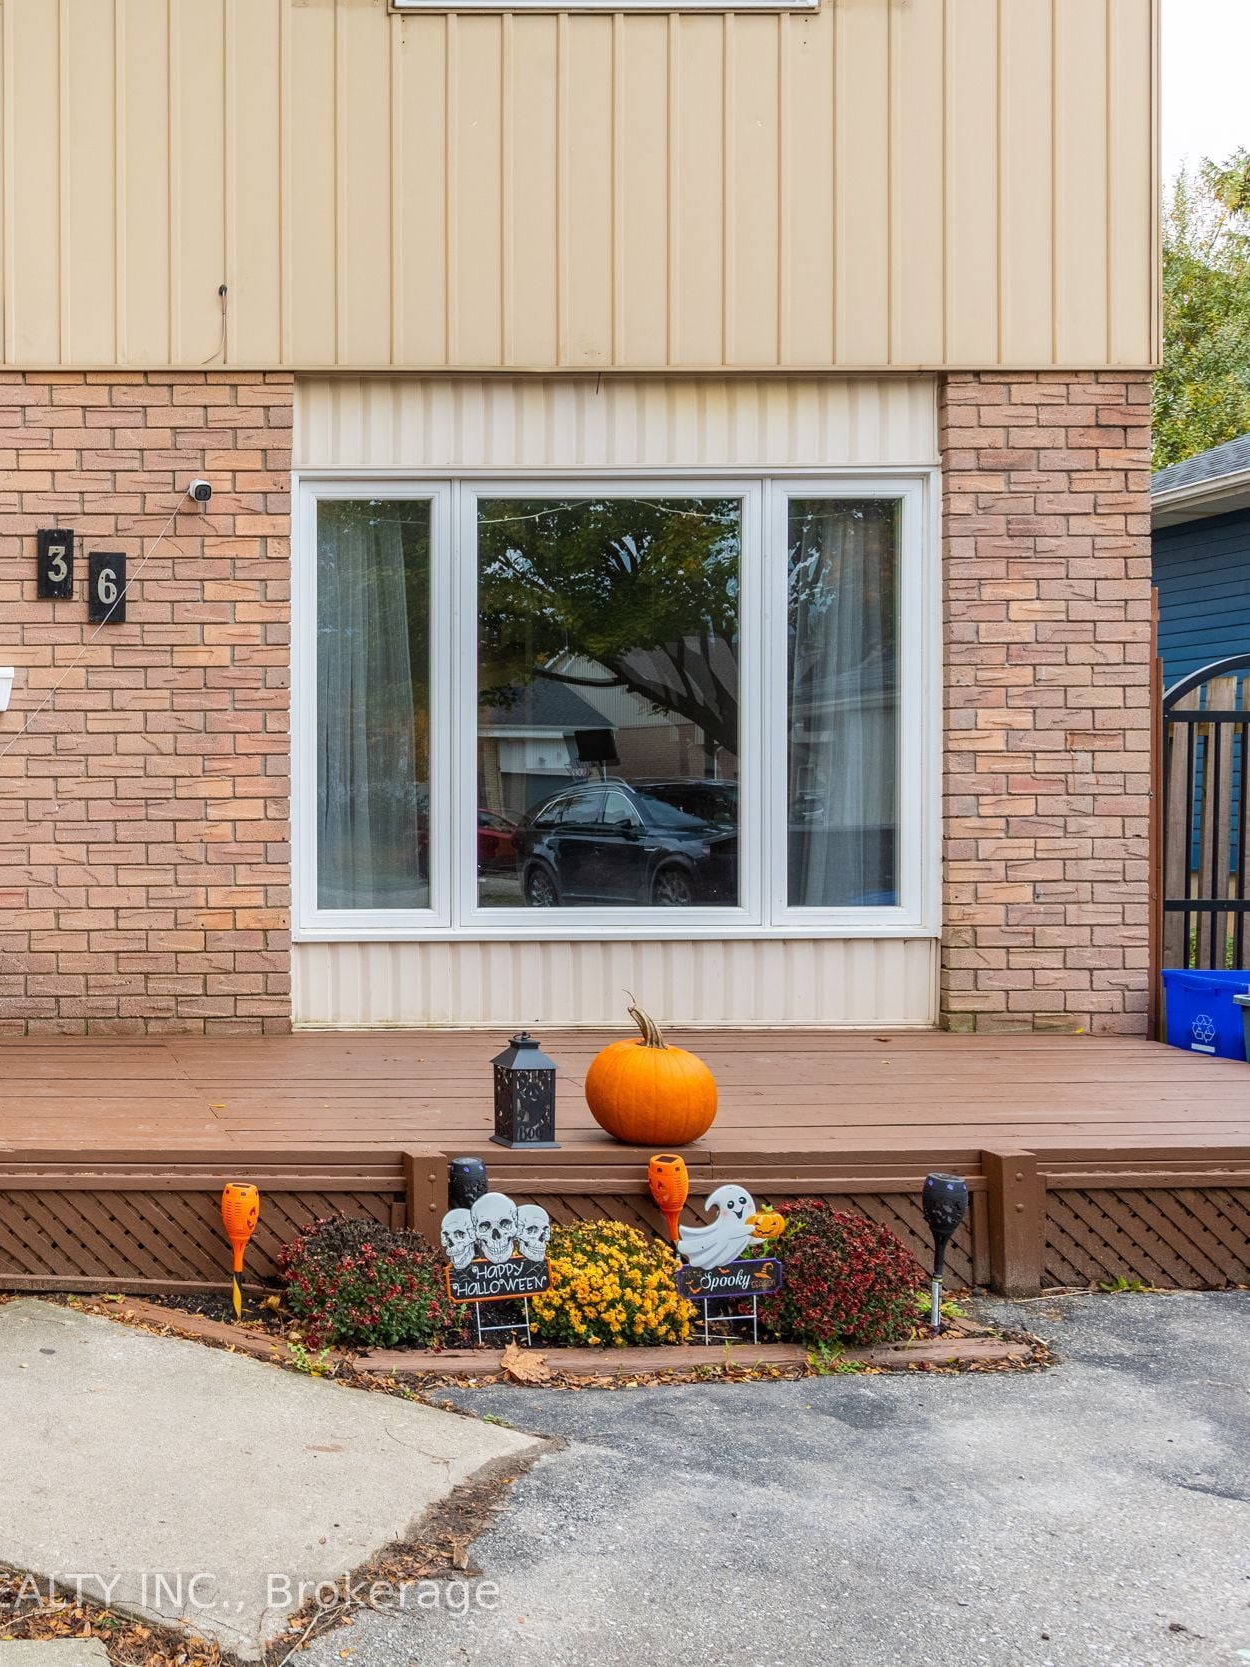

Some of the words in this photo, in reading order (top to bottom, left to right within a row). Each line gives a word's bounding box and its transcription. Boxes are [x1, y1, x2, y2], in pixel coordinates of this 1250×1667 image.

[48, 546, 68, 582] 3
[98, 568, 117, 604] 6
[700, 1269, 751, 1291] Spooky
